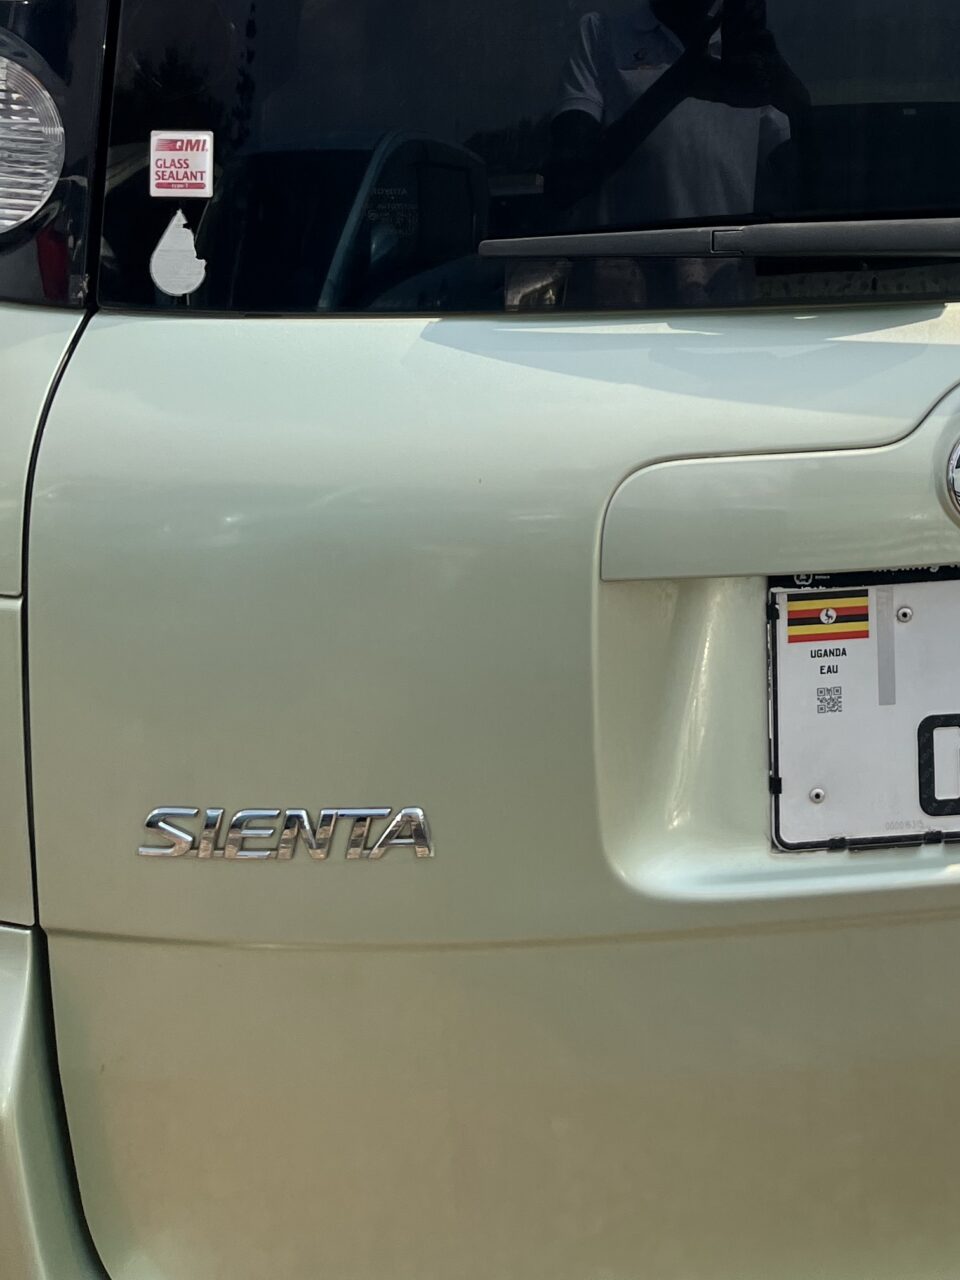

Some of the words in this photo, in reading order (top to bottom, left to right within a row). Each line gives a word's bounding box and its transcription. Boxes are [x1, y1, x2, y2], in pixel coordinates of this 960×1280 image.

[155, 158, 189, 169] GLASS
[155, 170, 206, 182] SEALANT
[810, 647, 847, 659] UGANDA
[819, 664, 839, 675] EAU
[138, 806, 435, 860] SIENTA
